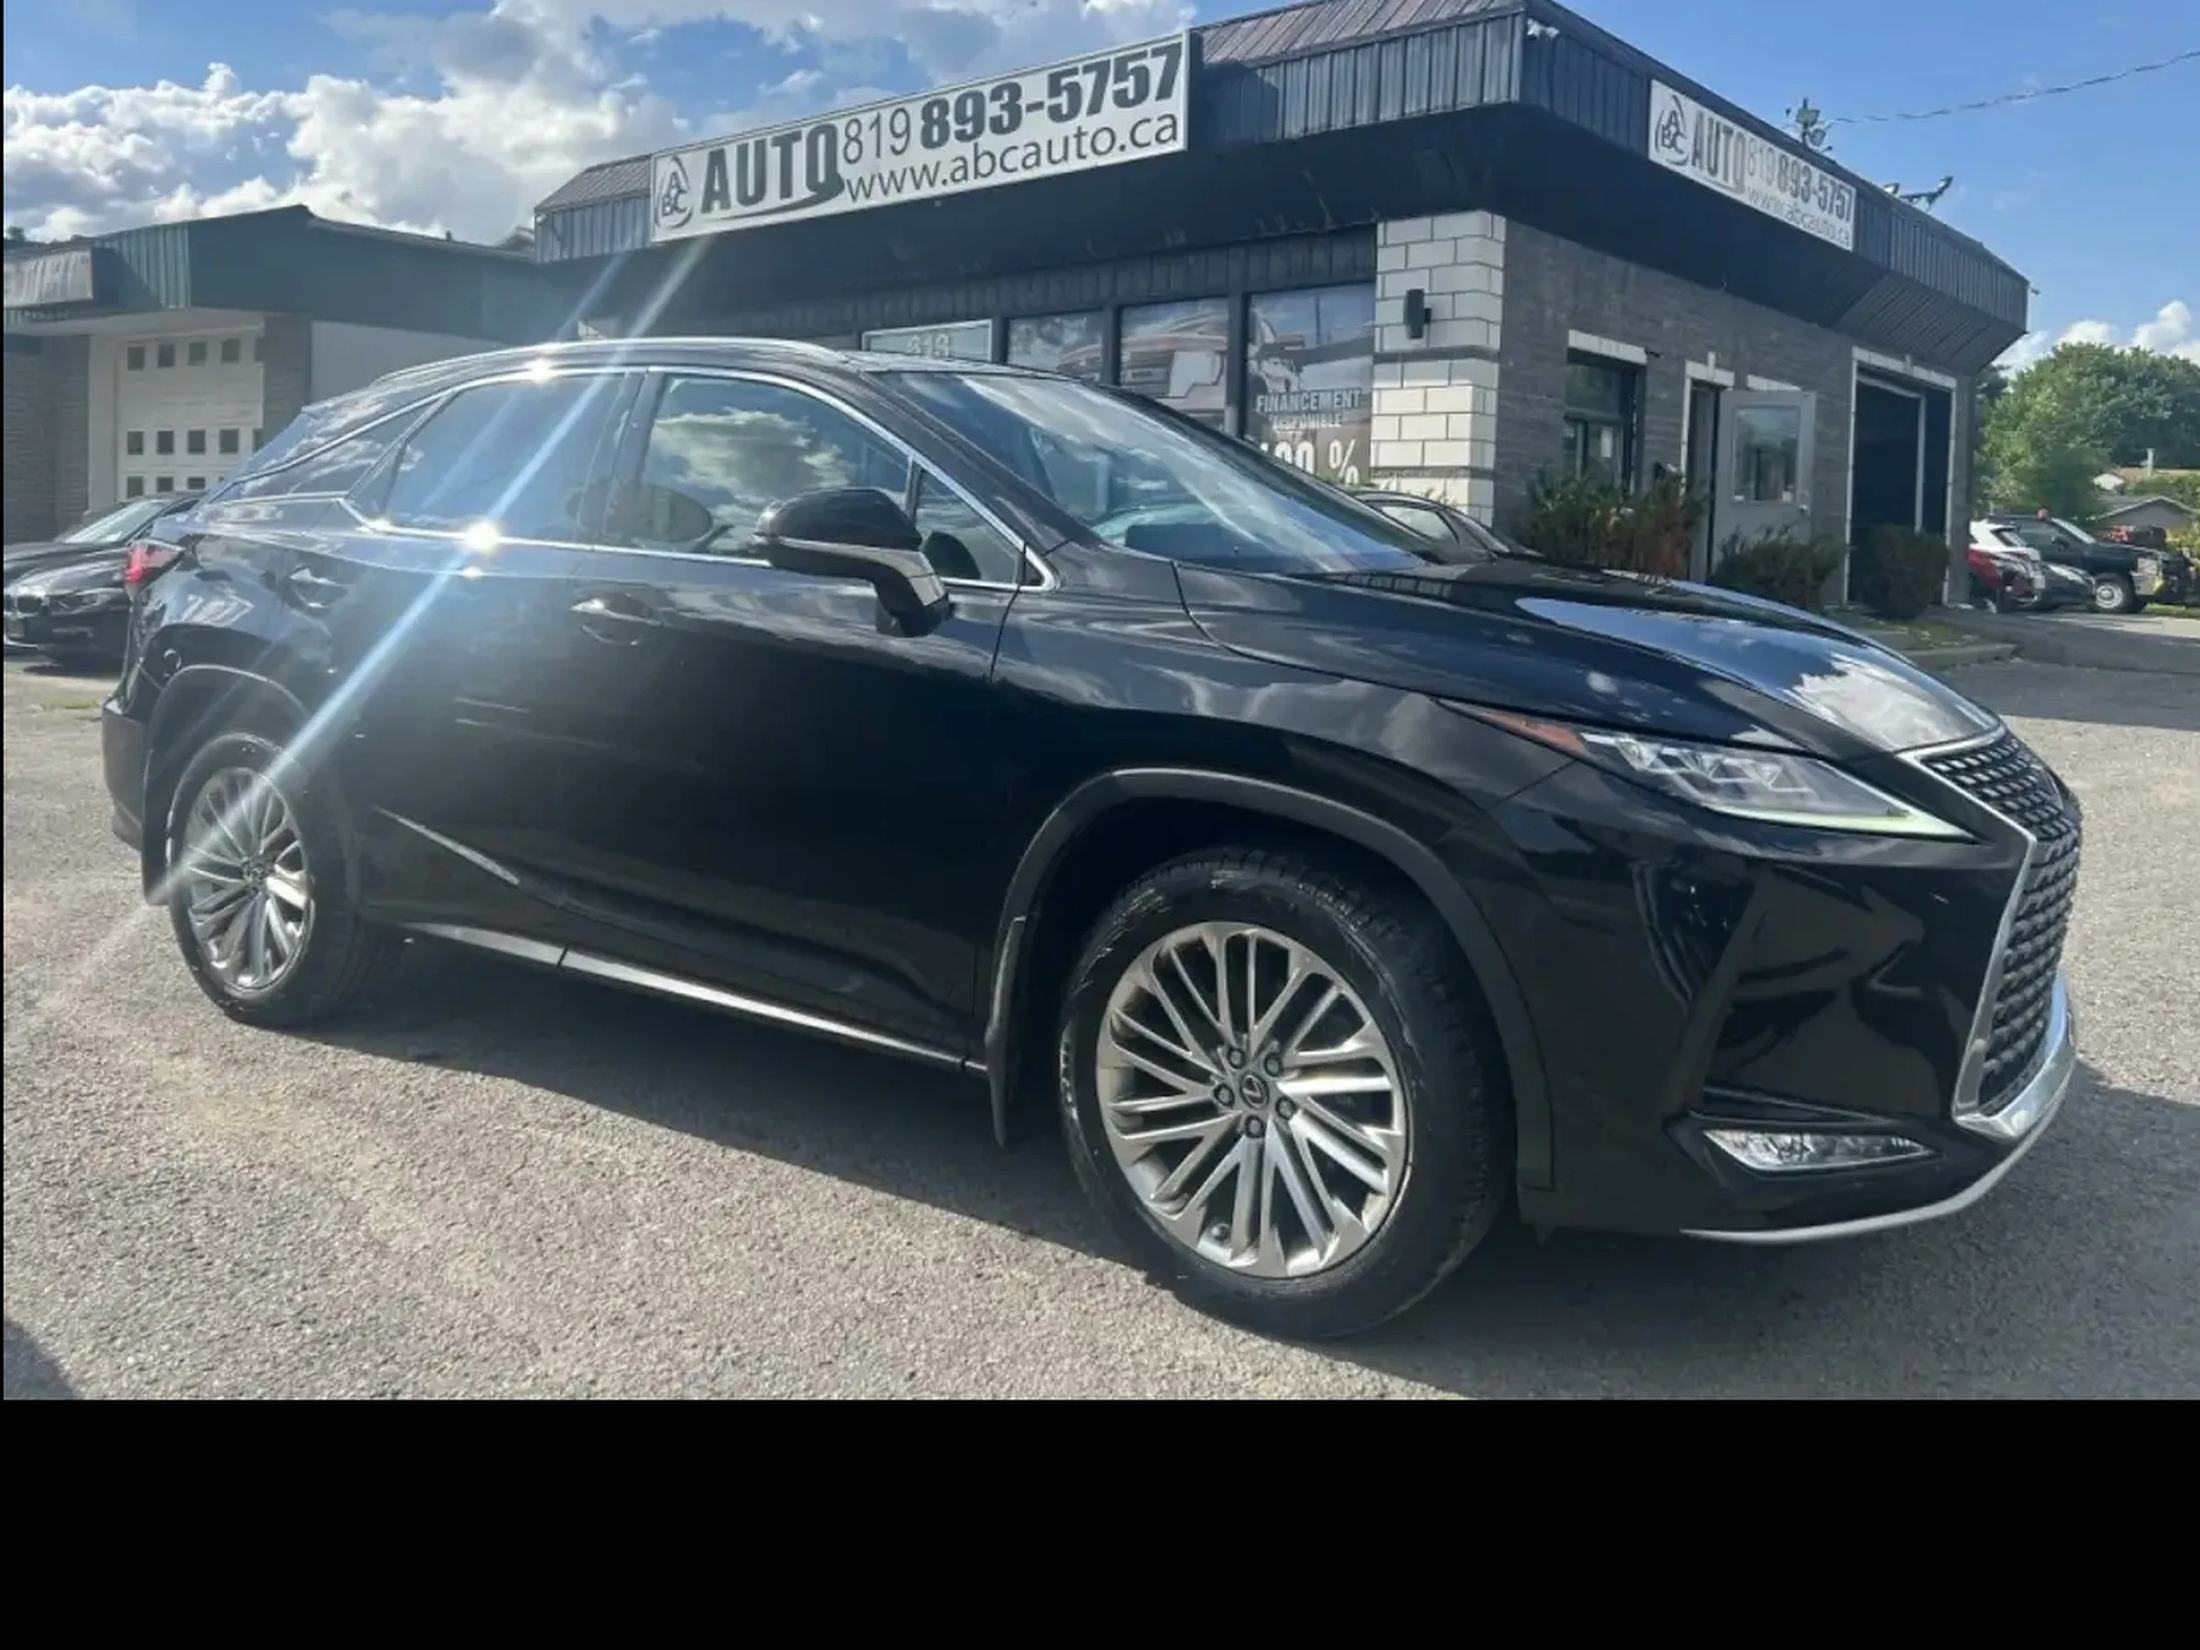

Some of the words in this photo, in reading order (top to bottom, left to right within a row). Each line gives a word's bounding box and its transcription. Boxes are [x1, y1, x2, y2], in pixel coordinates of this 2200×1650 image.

[842, 107, 912, 165] 819
[920, 42, 1184, 150] 893-5757
[701, 123, 845, 215] AUTO
[846, 112, 1179, 203] www.abcauto.ca
[1692, 109, 1746, 190] AUTO
[1778, 153, 1853, 224] 893-5757
[1256, 388, 1361, 413] FINANCEMENT
